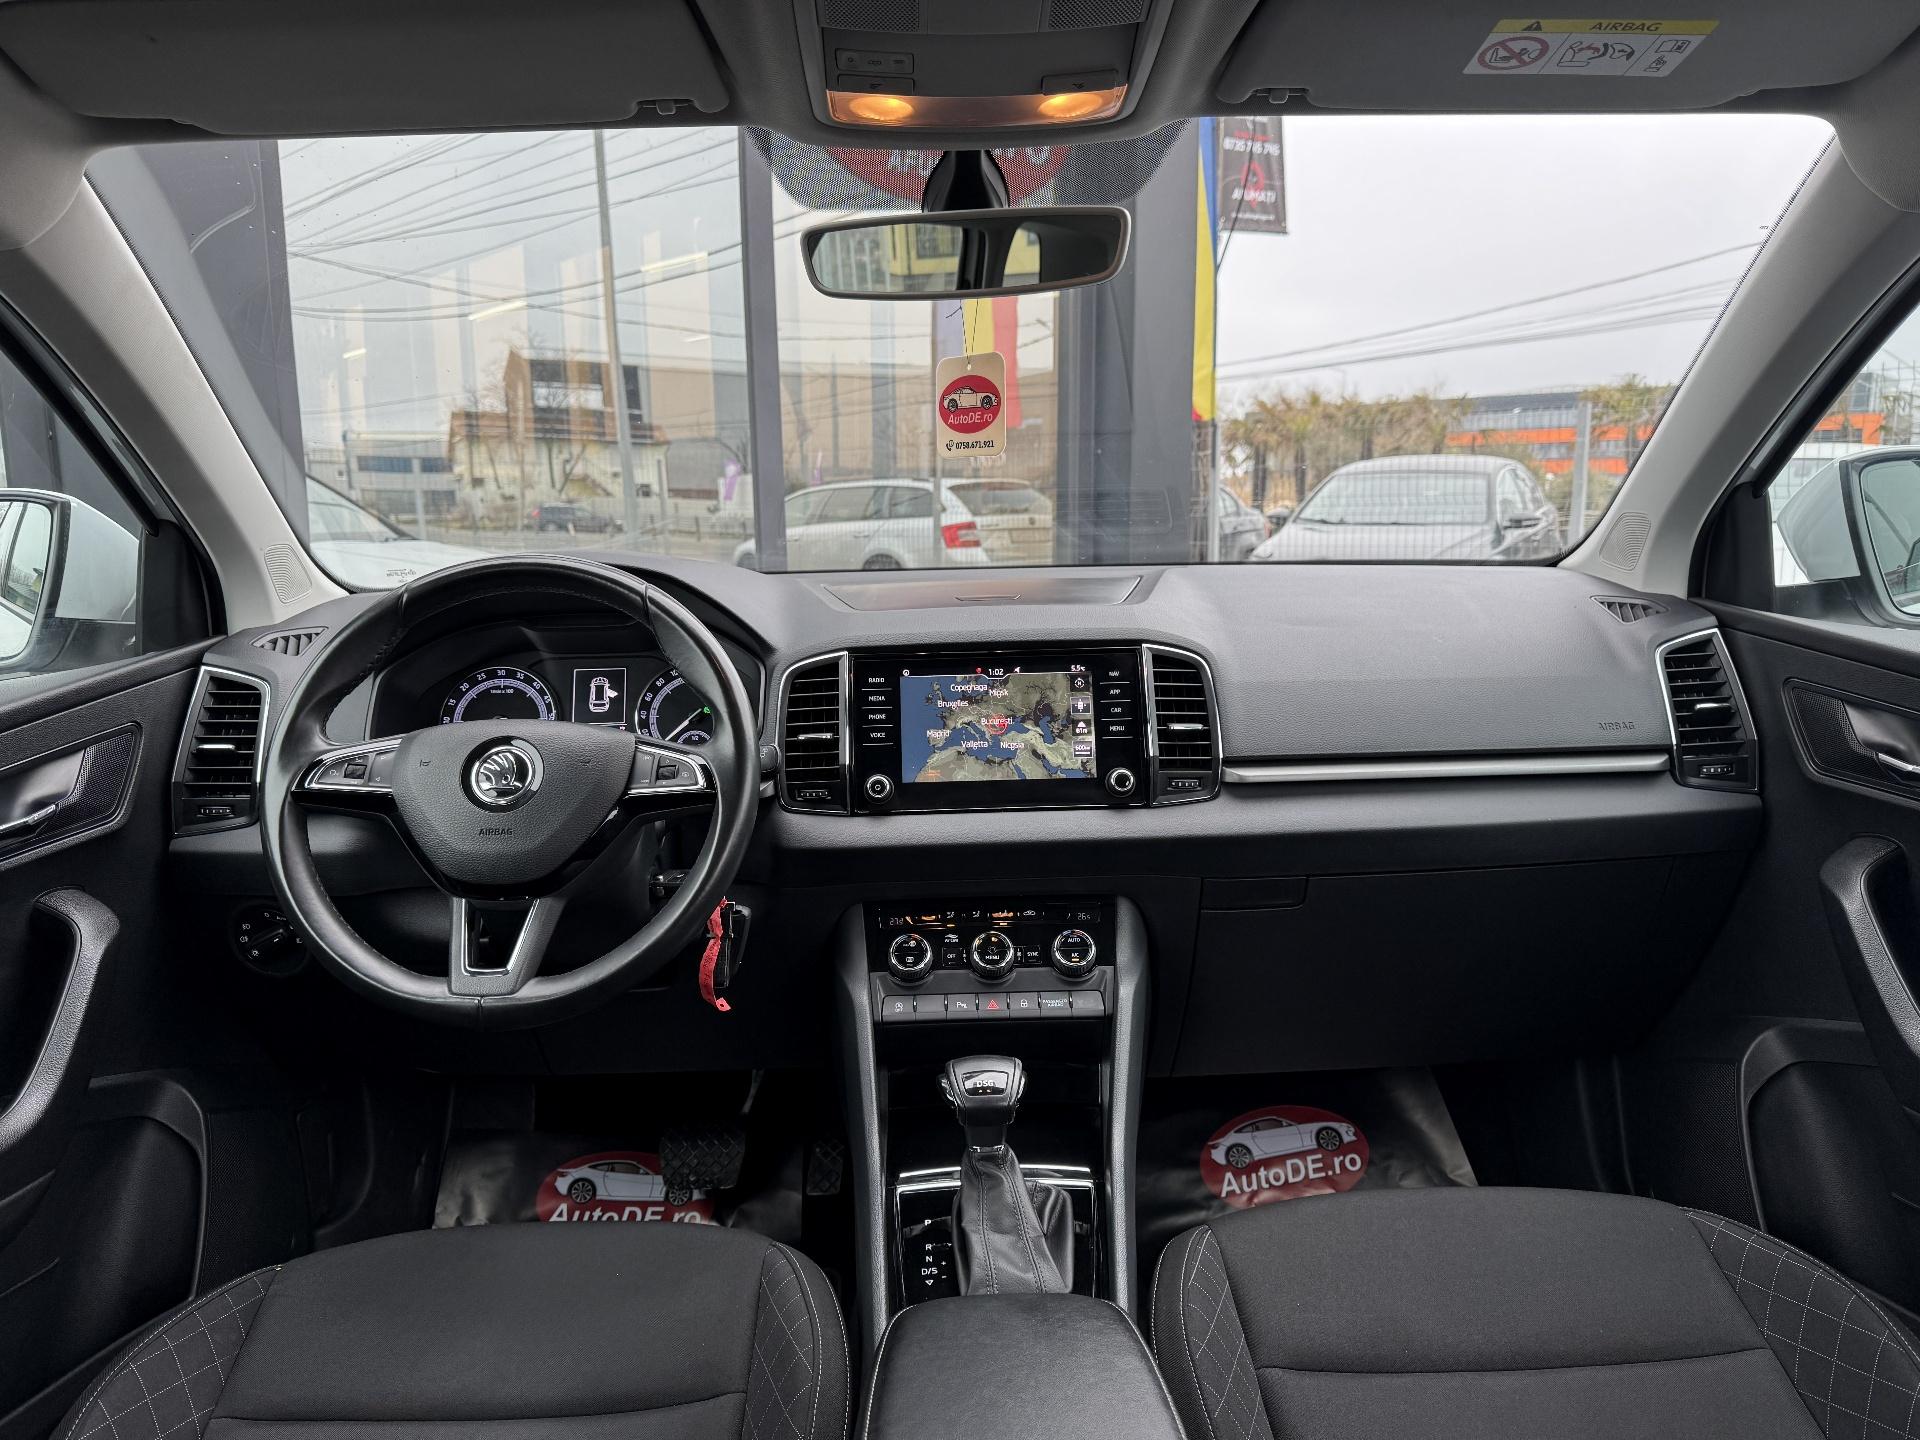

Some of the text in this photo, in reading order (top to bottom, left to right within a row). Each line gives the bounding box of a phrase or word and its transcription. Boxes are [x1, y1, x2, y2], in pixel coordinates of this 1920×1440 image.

[1589, 21, 1663, 32] AIRBAG
[947, 413, 993, 424] AutoDE.ro
[955, 440, 994, 450] 0758.671.921
[476, 672, 487, 681] 25
[516, 671, 525, 680] 35
[988, 668, 1004, 676] 1:02
[459, 682, 470, 692] 20
[532, 681, 541, 690] 40
[656, 677, 665, 687] 80
[448, 698, 457, 706] 15
[644, 692, 653, 702] 60
[640, 710, 647, 719] 40
[1598, 721, 1635, 731] AIRBAG
[478, 828, 513, 836] AIRBAG
[1220, 1153, 1362, 1198] AutoDE.ro
[548, 1203, 703, 1223] AutoDEro
[921, 1267, 938, 1276] D/S
